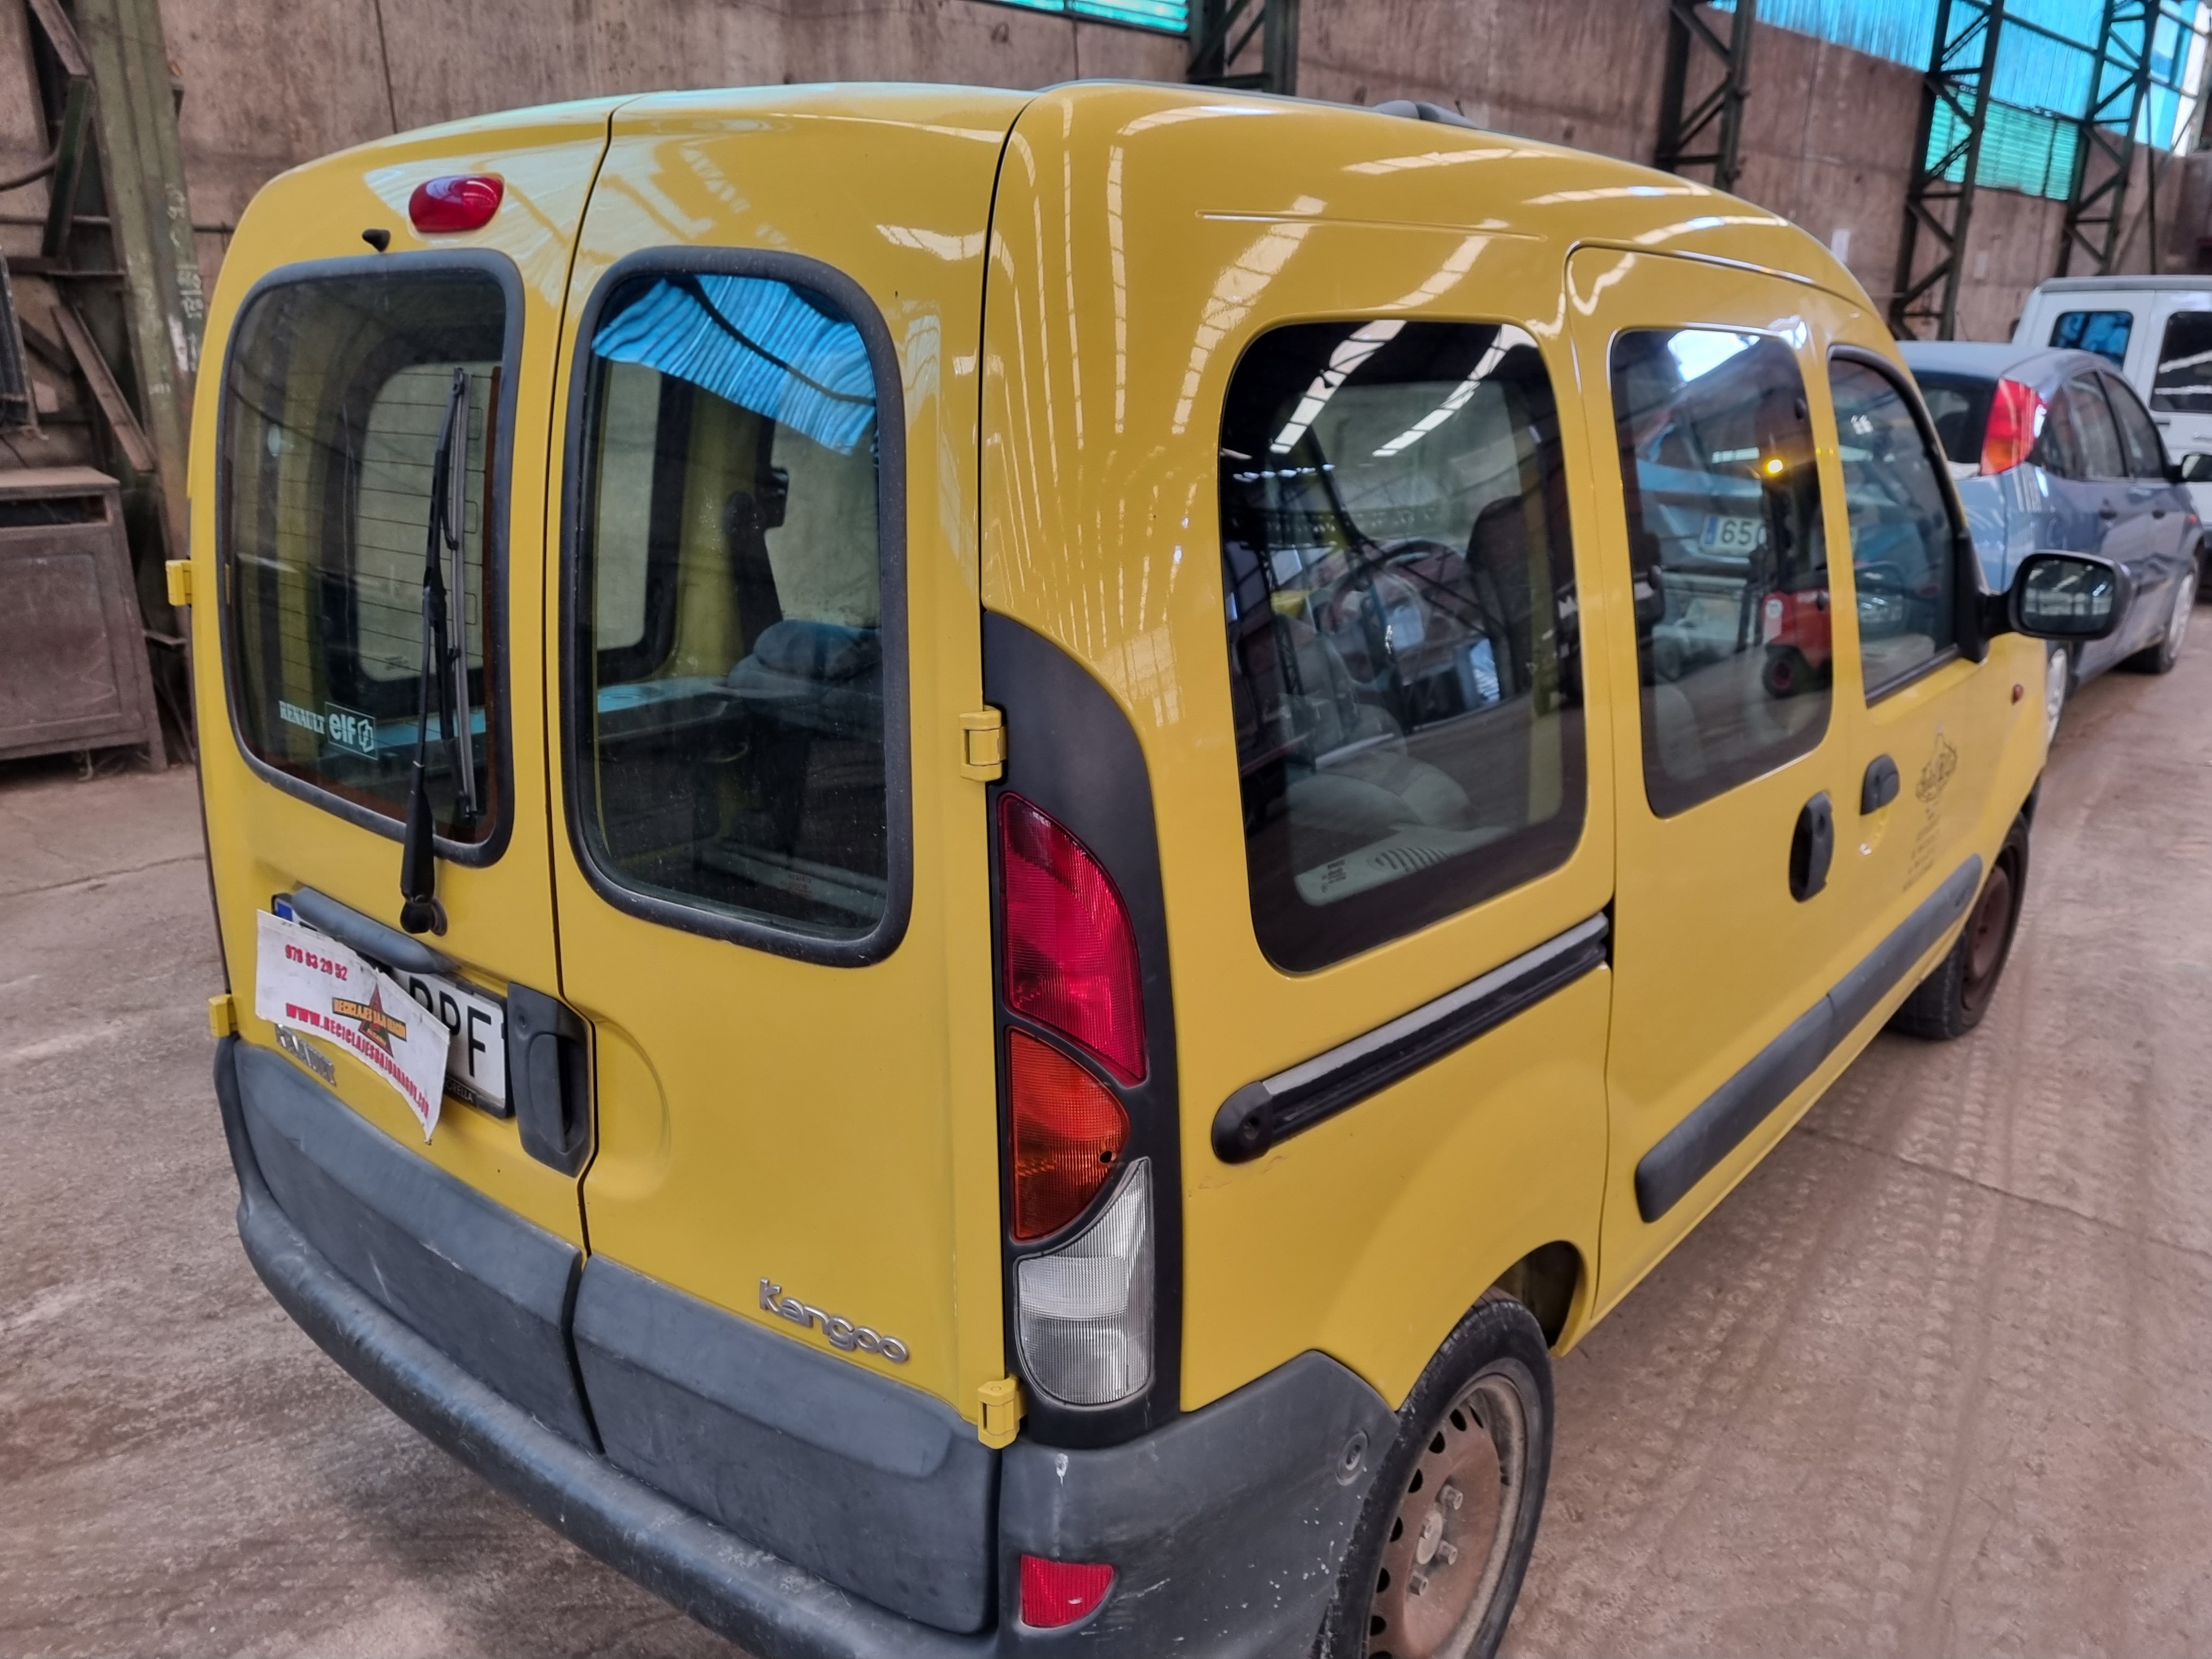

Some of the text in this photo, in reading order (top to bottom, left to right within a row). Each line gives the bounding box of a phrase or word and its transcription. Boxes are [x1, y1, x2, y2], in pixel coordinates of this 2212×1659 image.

[279, 700, 355, 745] RENAULT elf
[335, 964, 348, 981] 52
